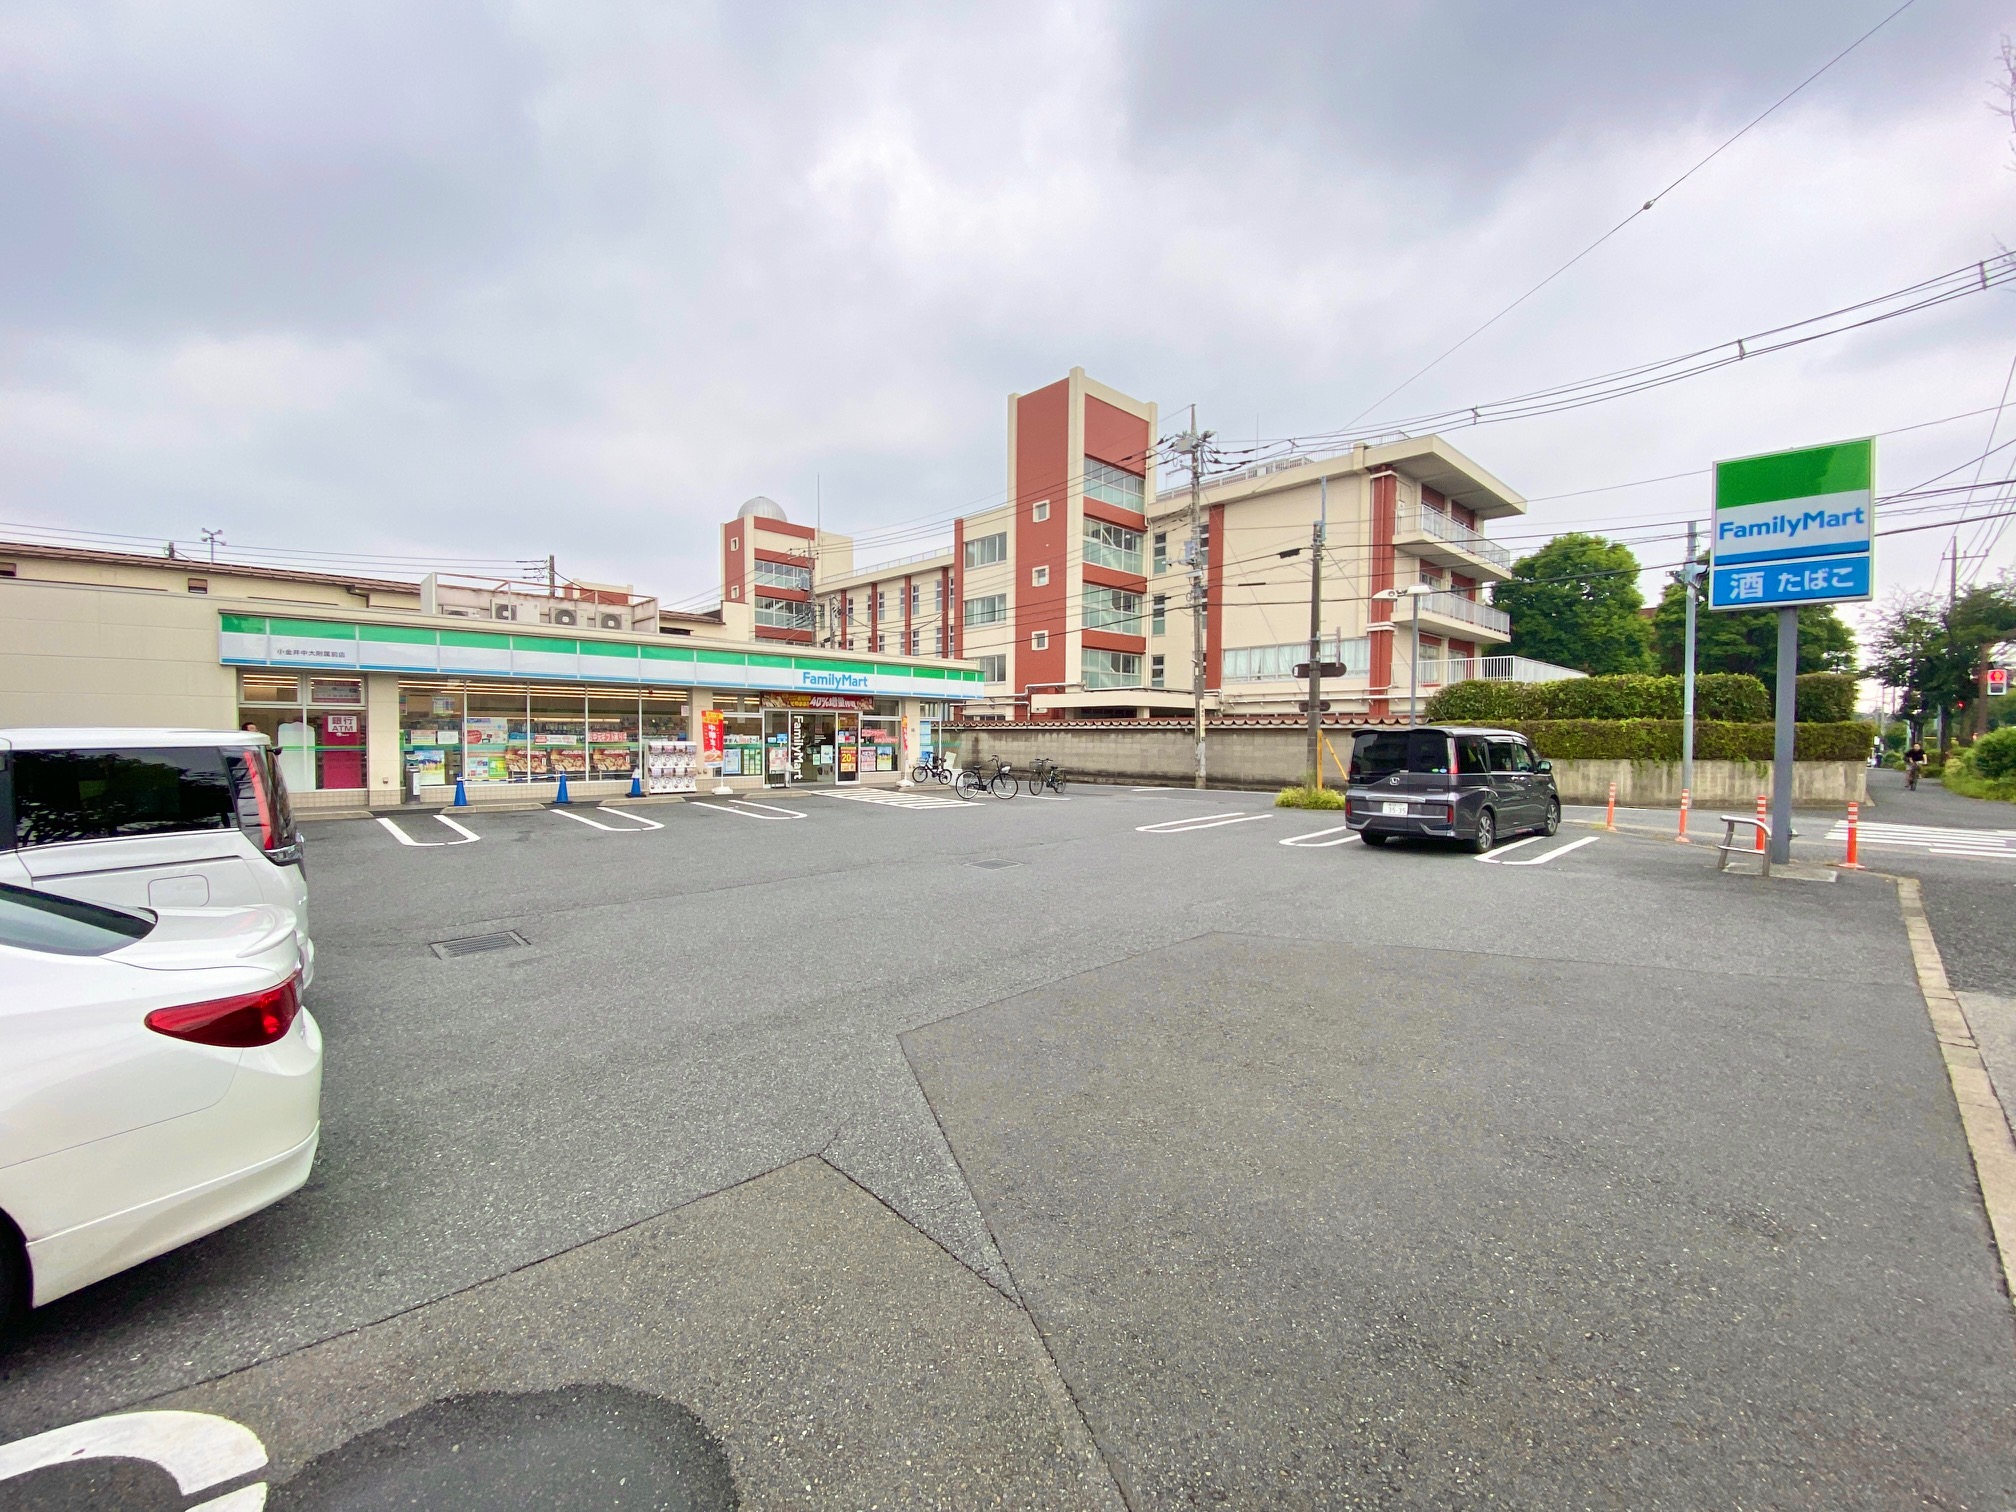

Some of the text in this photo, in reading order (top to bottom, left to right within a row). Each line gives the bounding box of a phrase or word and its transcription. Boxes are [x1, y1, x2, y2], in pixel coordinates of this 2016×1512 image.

[1719, 507, 1865, 540] FamilyMart
[1729, 567, 1854, 600] 酒 たばこ
[277, 648, 346, 659] 小金井中大附属前店
[803, 671, 868, 690] FamilyMart
[331, 716, 354, 725] 銀行
[793, 715, 804, 780] FamilyMart
